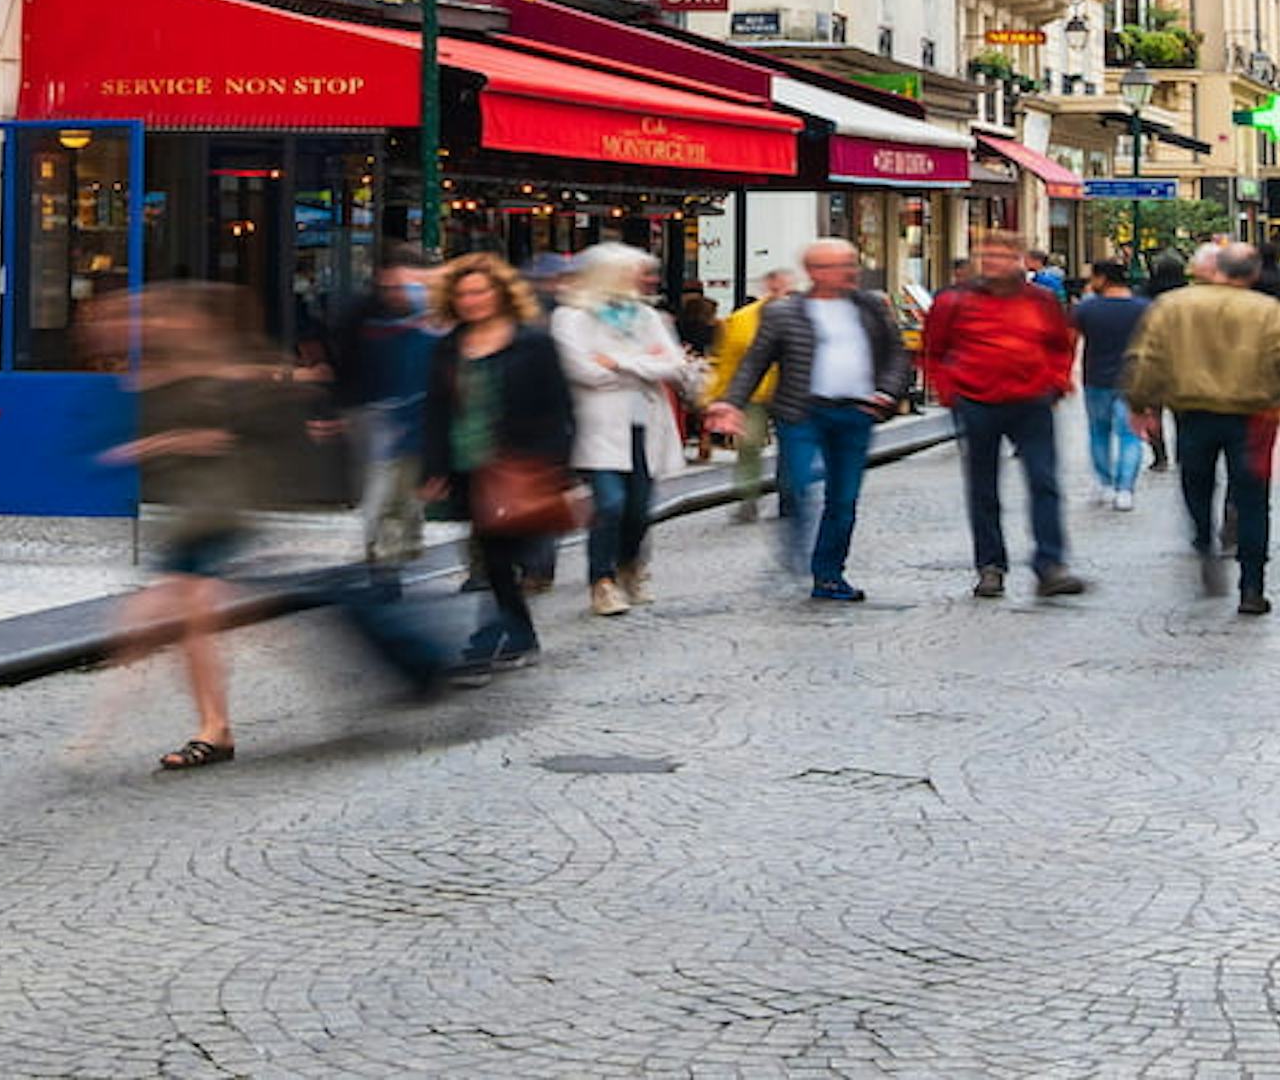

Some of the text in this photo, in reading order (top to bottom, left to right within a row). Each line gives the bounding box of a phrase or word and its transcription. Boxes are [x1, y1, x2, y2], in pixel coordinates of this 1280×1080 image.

[100, 75, 365, 97] SERVICE NON STOP
